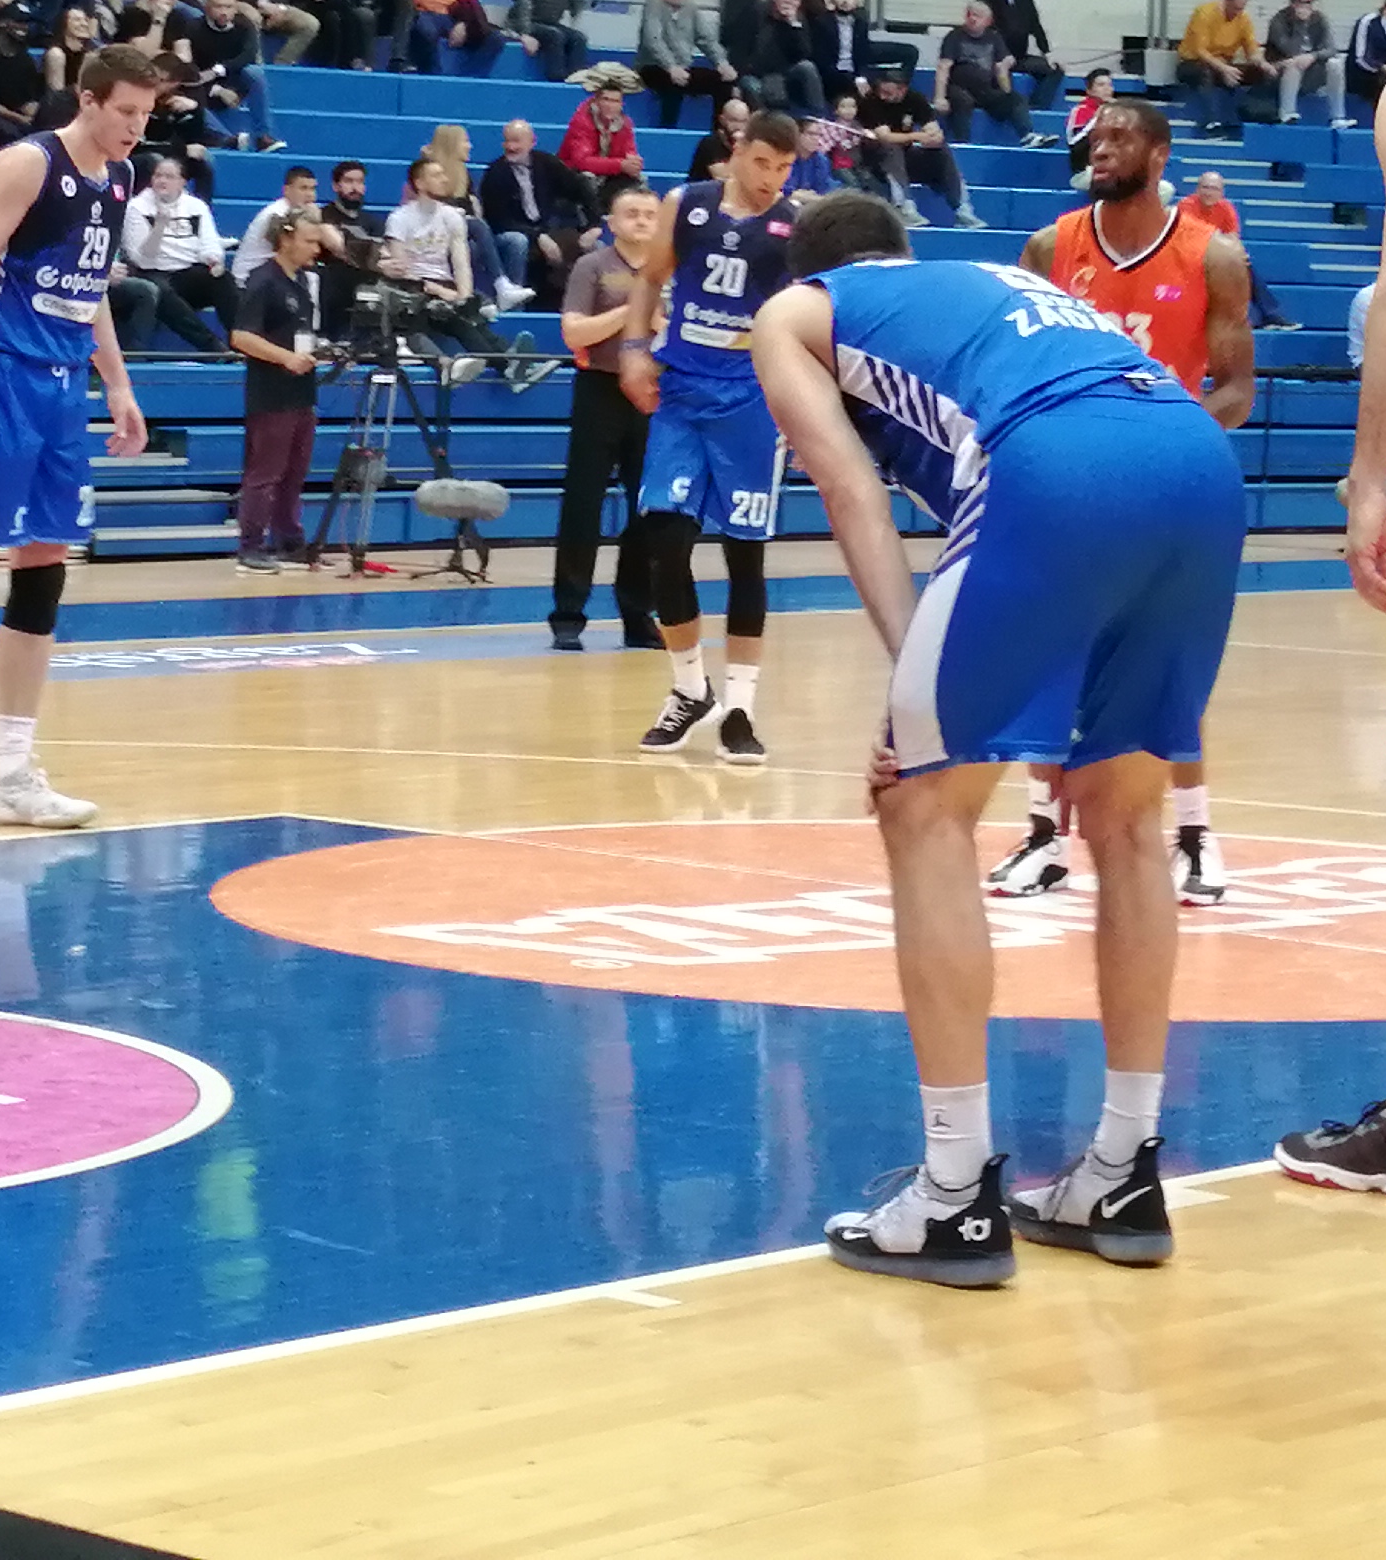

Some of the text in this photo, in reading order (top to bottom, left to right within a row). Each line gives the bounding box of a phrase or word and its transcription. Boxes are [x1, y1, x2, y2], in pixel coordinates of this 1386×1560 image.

[77, 225, 111, 270] 29
[702, 253, 749, 298] 20
[1101, 311, 1154, 355] 3
[729, 490, 769, 528] 20
